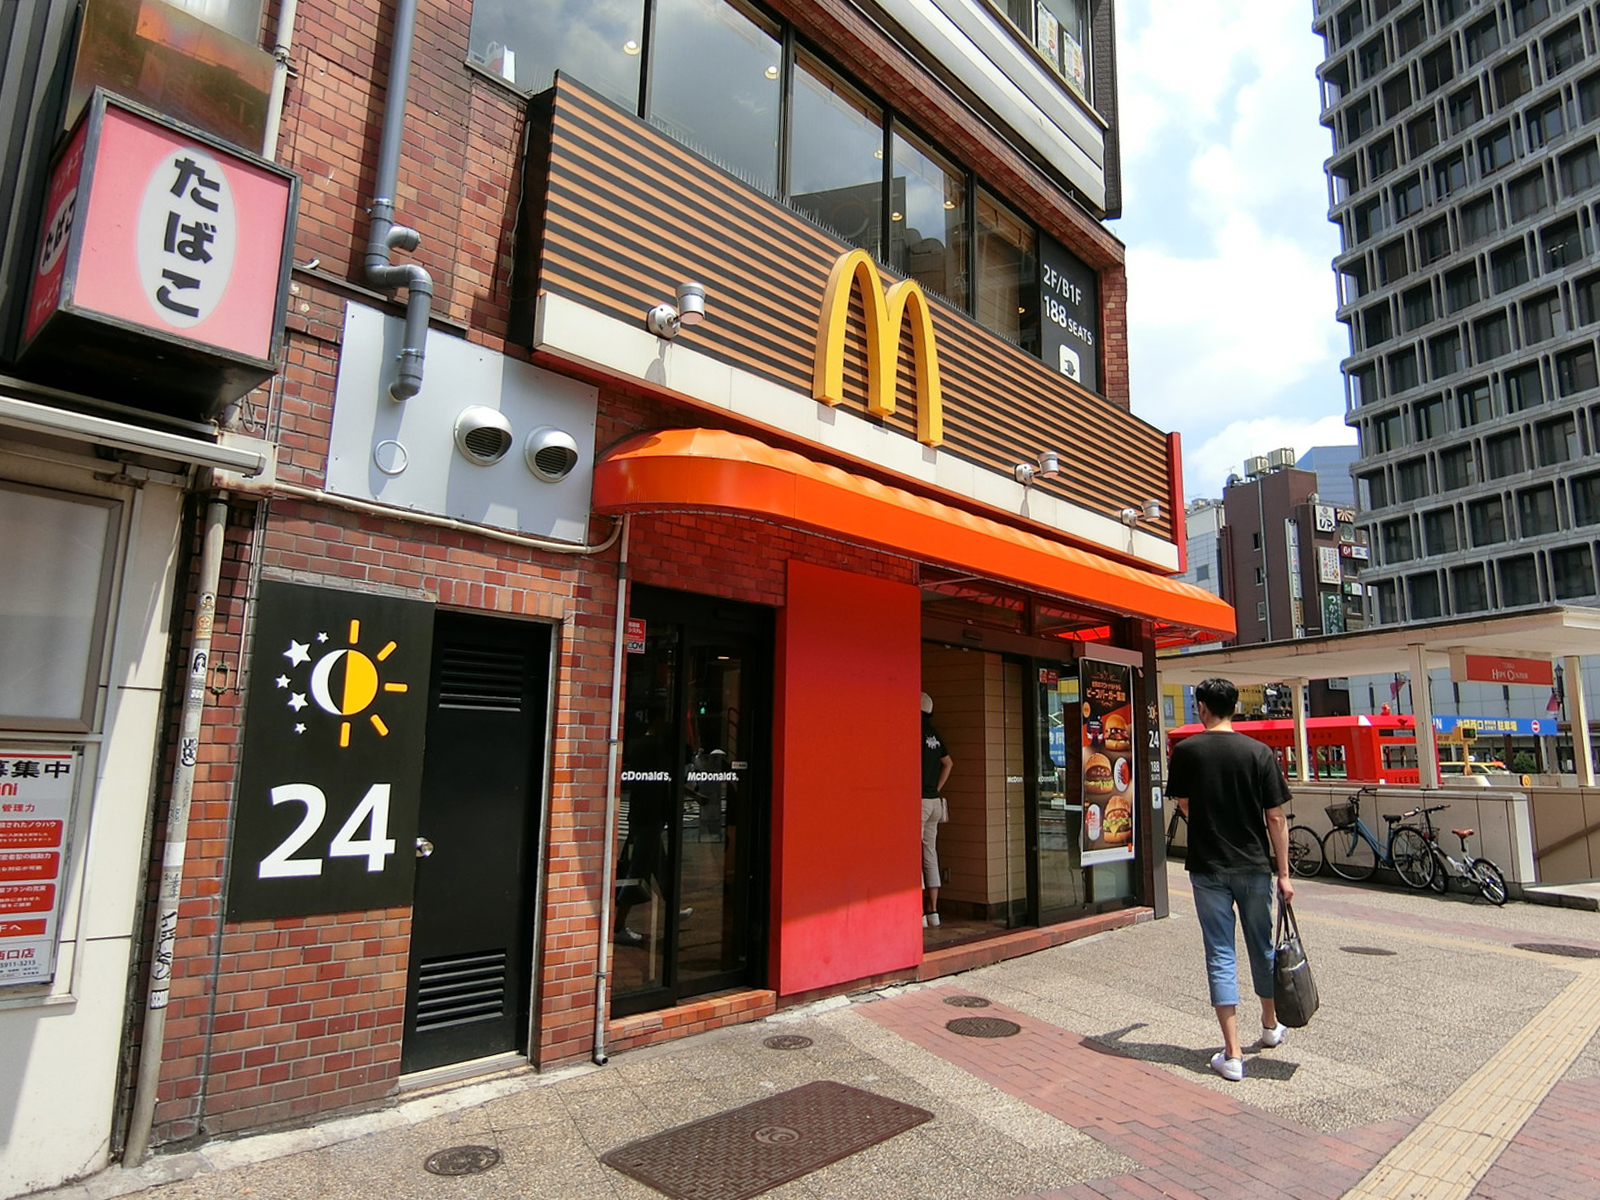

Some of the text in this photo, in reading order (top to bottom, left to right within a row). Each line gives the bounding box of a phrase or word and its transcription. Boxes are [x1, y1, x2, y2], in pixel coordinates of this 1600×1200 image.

[156, 157, 220, 318] たばこ
[1043, 264, 1082, 306] 2F/B1F
[1043, 295, 1093, 346] 188 SEATS
[1149, 730, 1159, 748] 24
[620, 771, 672, 782] cDonald's
[258, 783, 396, 879] 24
